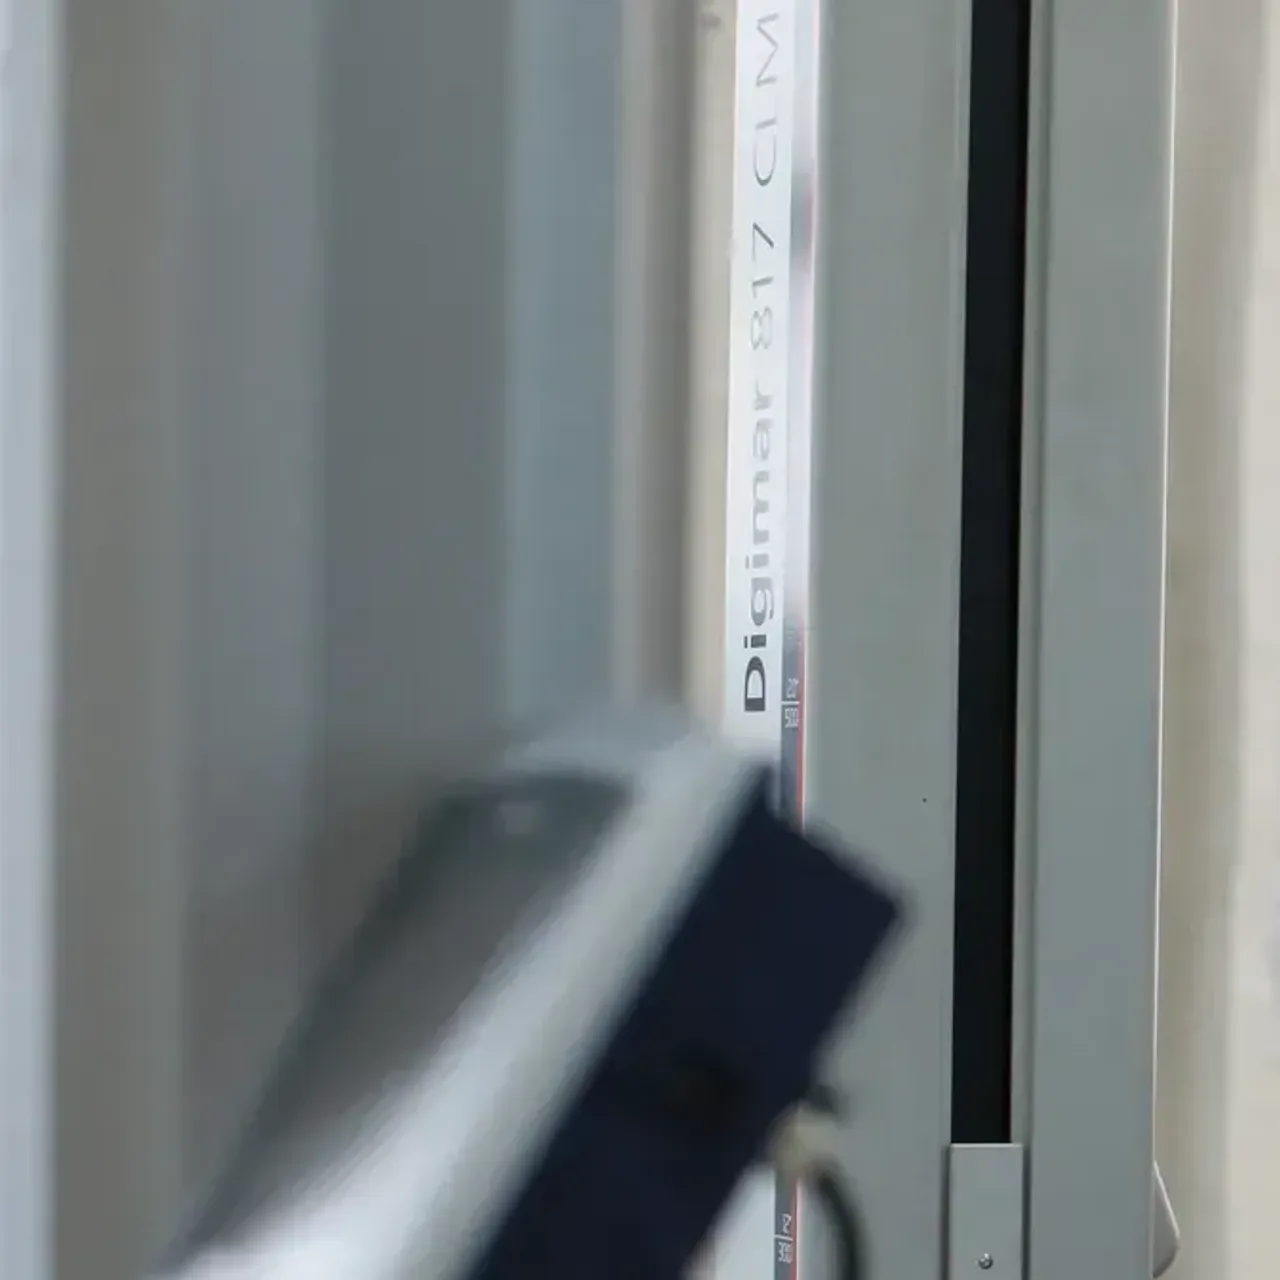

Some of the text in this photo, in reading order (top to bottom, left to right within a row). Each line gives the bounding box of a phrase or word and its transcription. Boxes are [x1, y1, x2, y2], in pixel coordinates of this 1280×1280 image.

[743, 12, 779, 712] Digimar 817 CLM
